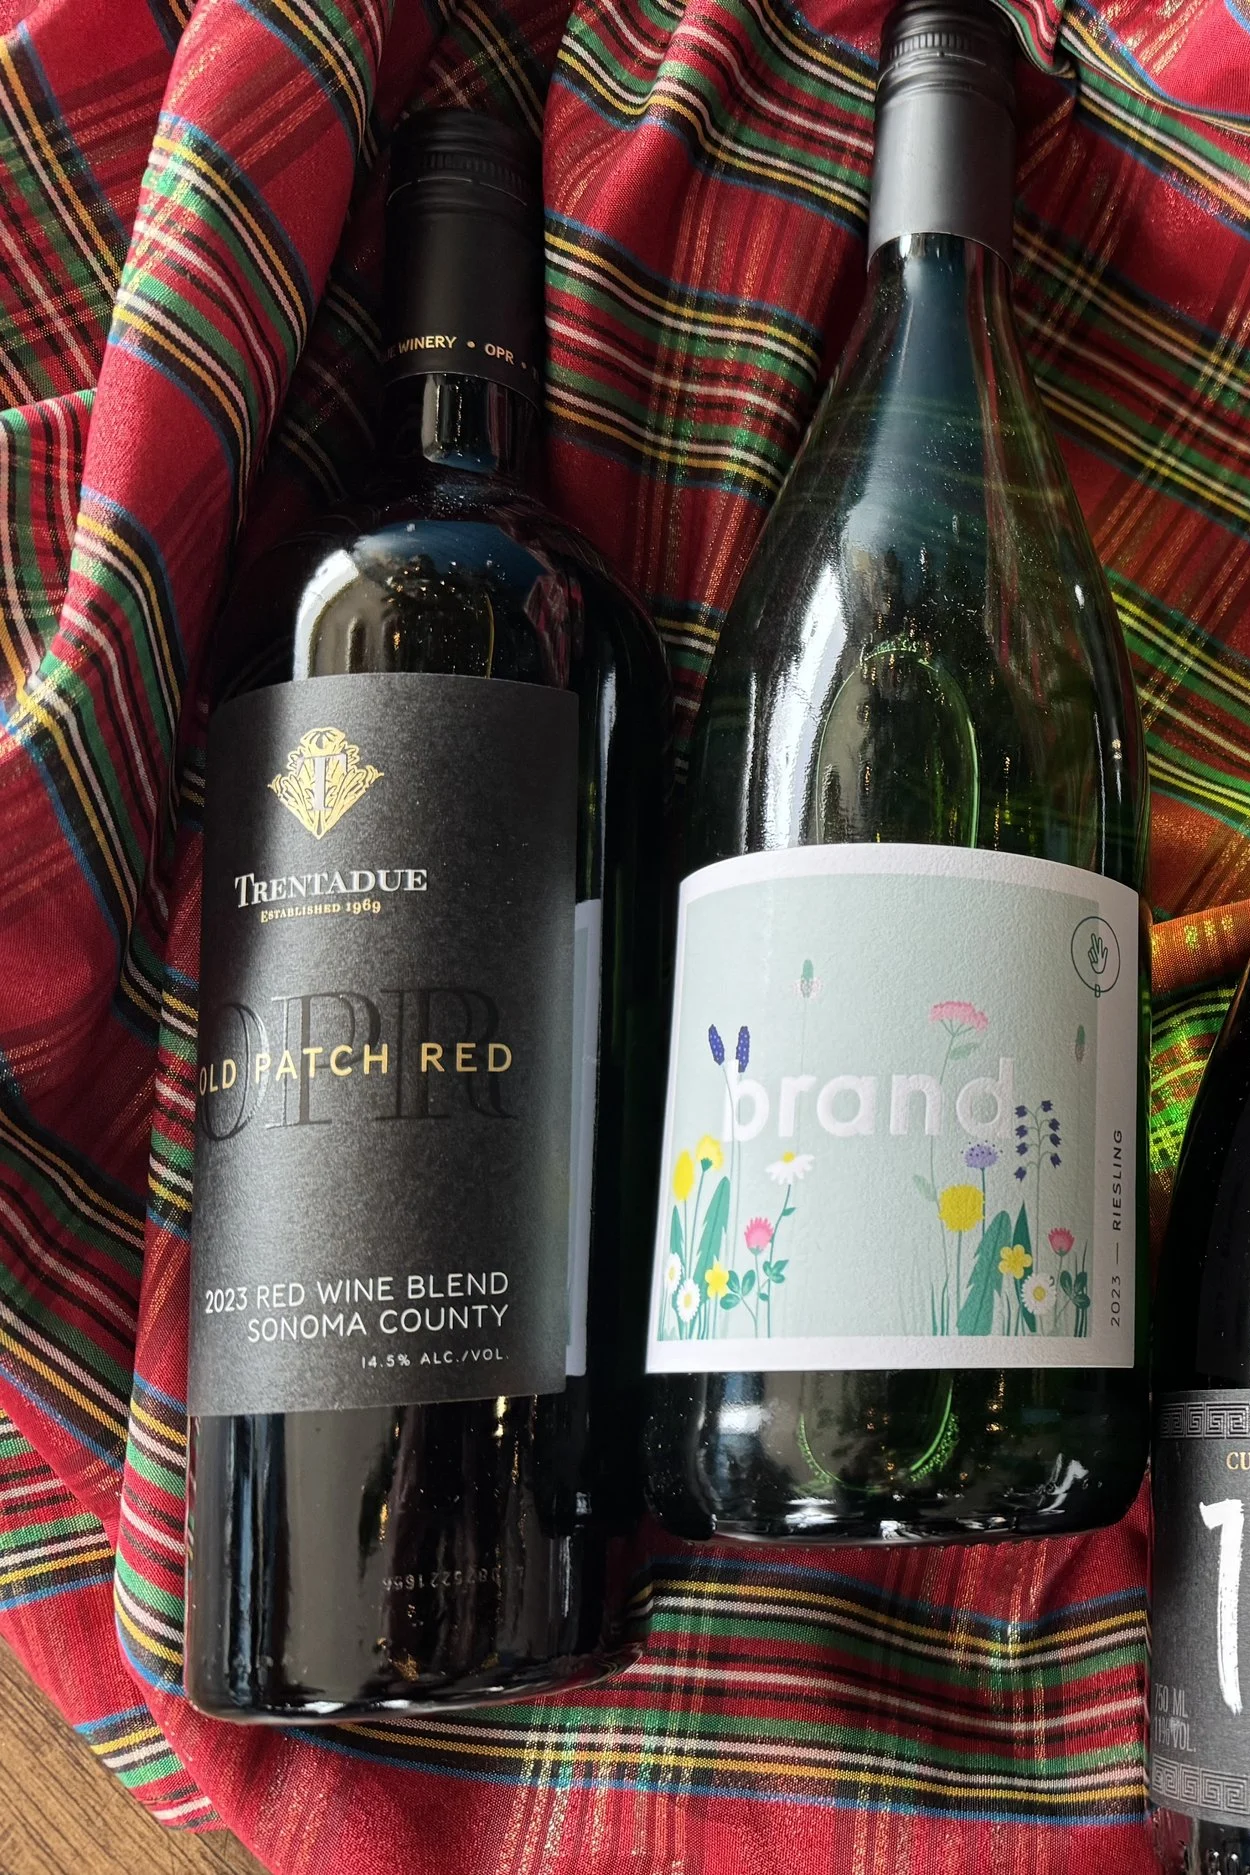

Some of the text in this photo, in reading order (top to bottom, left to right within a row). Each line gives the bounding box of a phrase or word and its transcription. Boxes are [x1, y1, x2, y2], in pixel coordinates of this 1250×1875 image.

[398, 335, 515, 365] WINERY OPR
[346, 898, 381, 914] 1969
[199, 986, 517, 1141] OPR
[199, 1042, 512, 1096] OLD PATCH RED
[721, 1056, 1015, 1142] brand
[1112, 1130, 1123, 1232] RIESLING
[205, 1272, 509, 1314] 2023 RED WINE BLEND
[1110, 1275, 1121, 1328] 2023
[248, 1304, 509, 1343] SONOMA COUNTY
[362, 1353, 411, 1369] 14.5%
[1154, 1682, 1189, 1718] 750 ML
